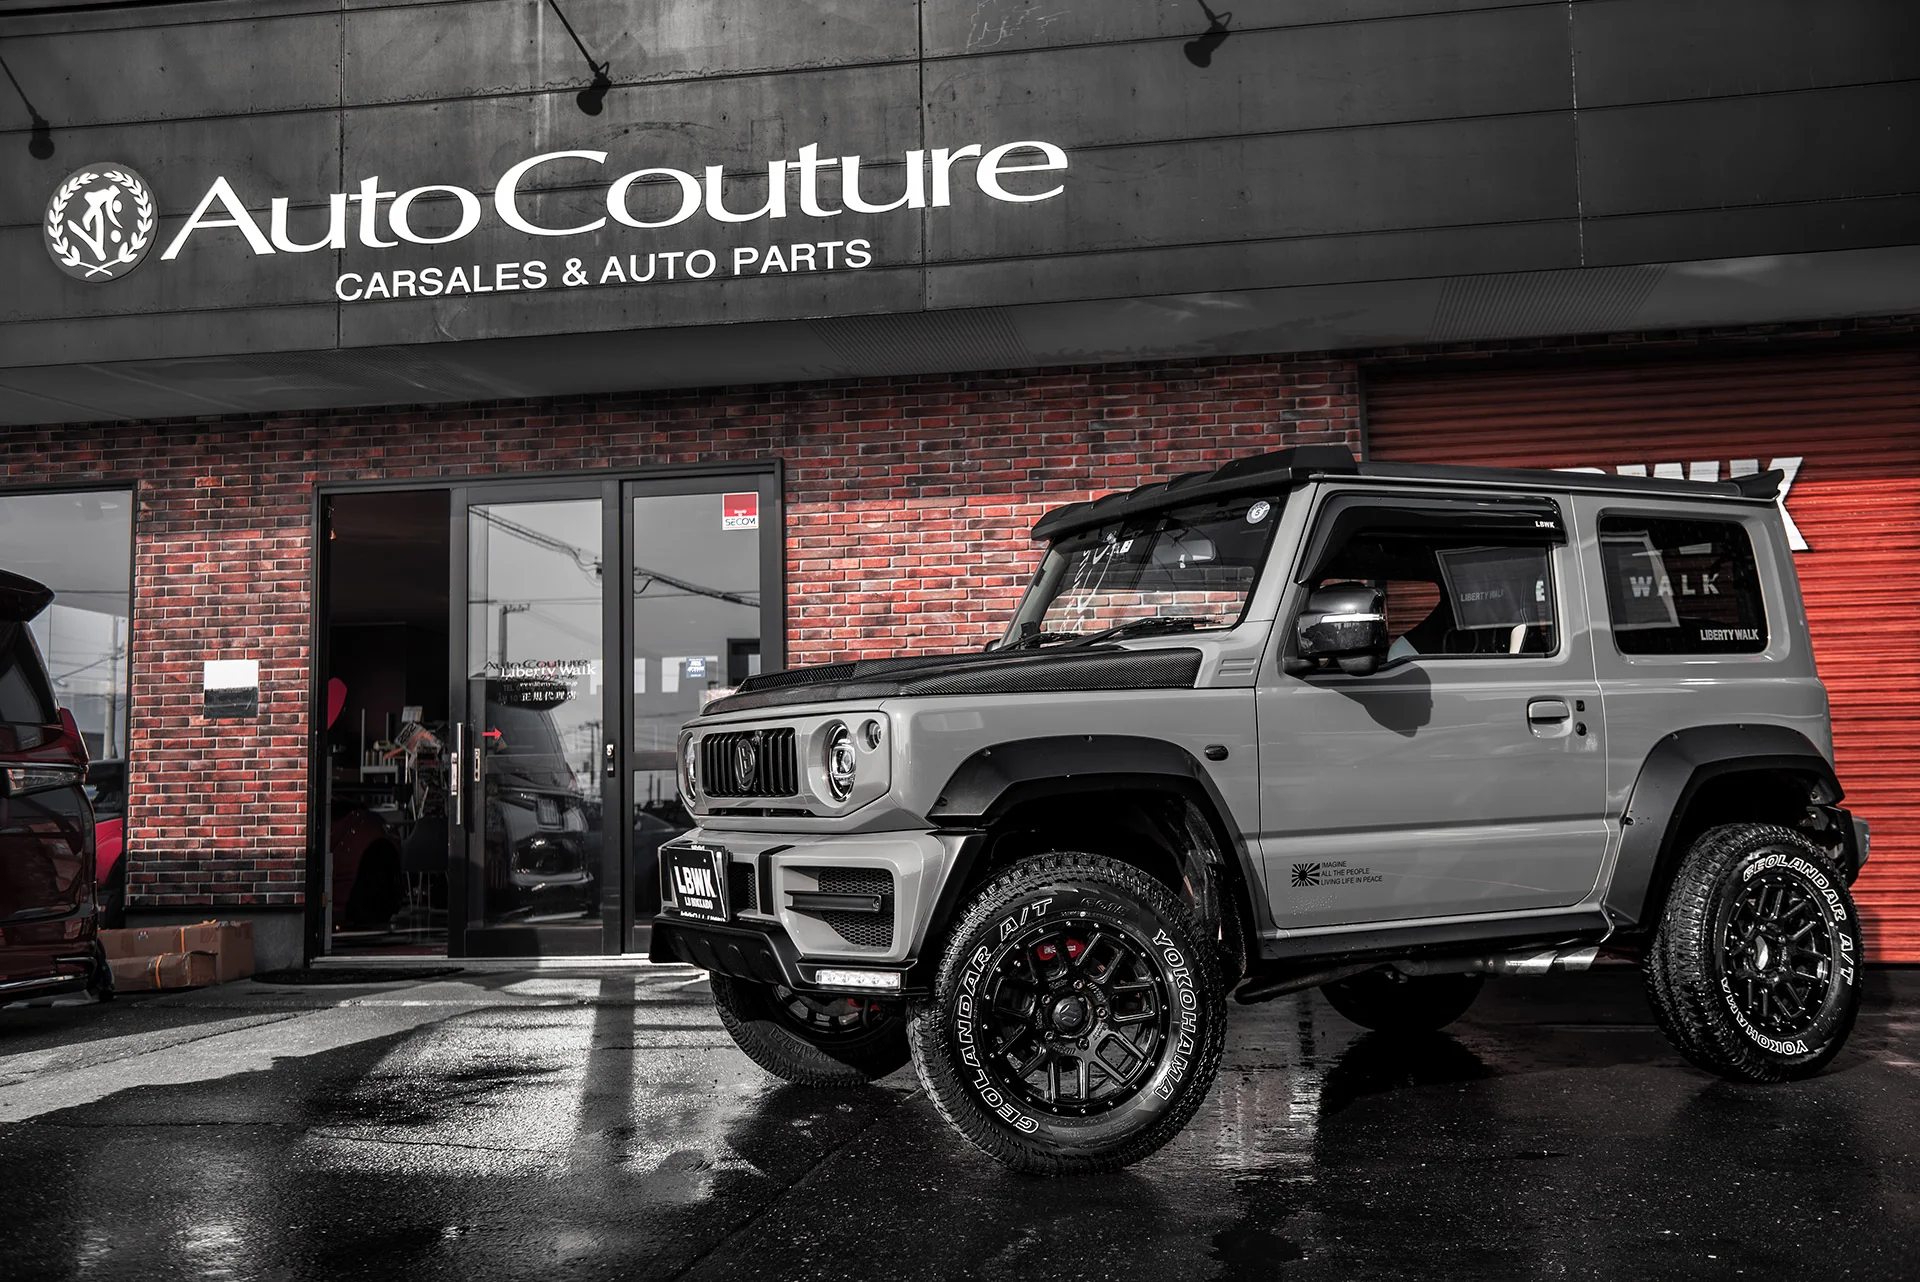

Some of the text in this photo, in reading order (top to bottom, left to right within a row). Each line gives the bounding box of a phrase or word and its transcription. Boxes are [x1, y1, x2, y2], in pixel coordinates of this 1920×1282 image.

[335, 238, 872, 301] CARSALES & AUTO PARTS
[725, 517, 756, 526] SECOM
[1535, 520, 1555, 529] LBWK
[1629, 573, 1720, 597] WALK
[1700, 628, 1759, 641] LIBERTY WALK
[501, 665, 556, 678] Liberty
[559, 663, 597, 676] Walk
[1321, 860, 1347, 868] IMAGINE
[1346, 868, 1370, 876] PEOPLE
[674, 866, 717, 897] LBWK
[1321, 878, 1341, 886] LIVING
[1743, 854, 1854, 986] GEOLANDAR A/T
[957, 898, 1053, 1134] GEOLANDAR A/T
[1152, 928, 1198, 1101] YOKOHAMA
[1720, 976, 1809, 1056] YOKOHAMA
